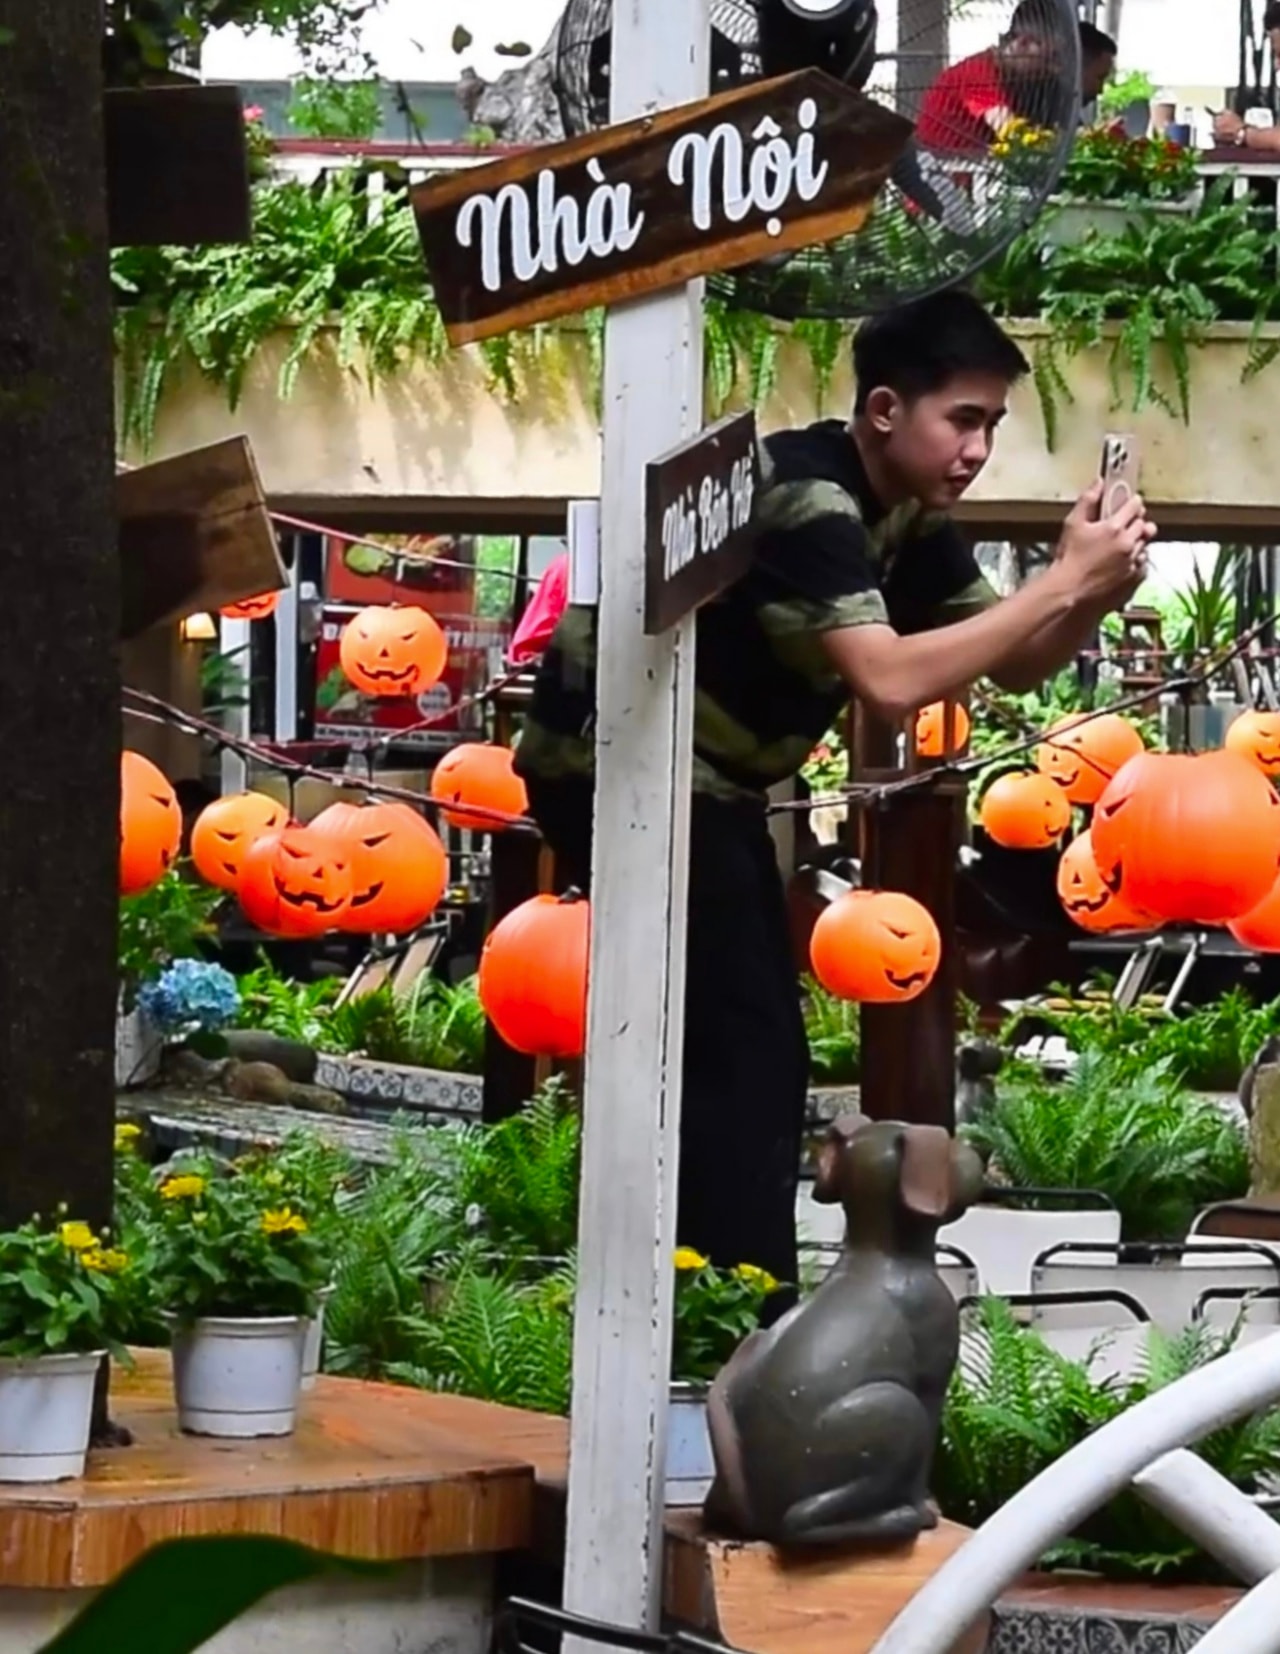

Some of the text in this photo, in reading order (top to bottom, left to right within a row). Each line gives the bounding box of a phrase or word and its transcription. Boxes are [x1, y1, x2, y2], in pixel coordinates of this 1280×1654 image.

[456, 98, 828, 291] Nhà Nội
[662, 485, 696, 581] Nhà
